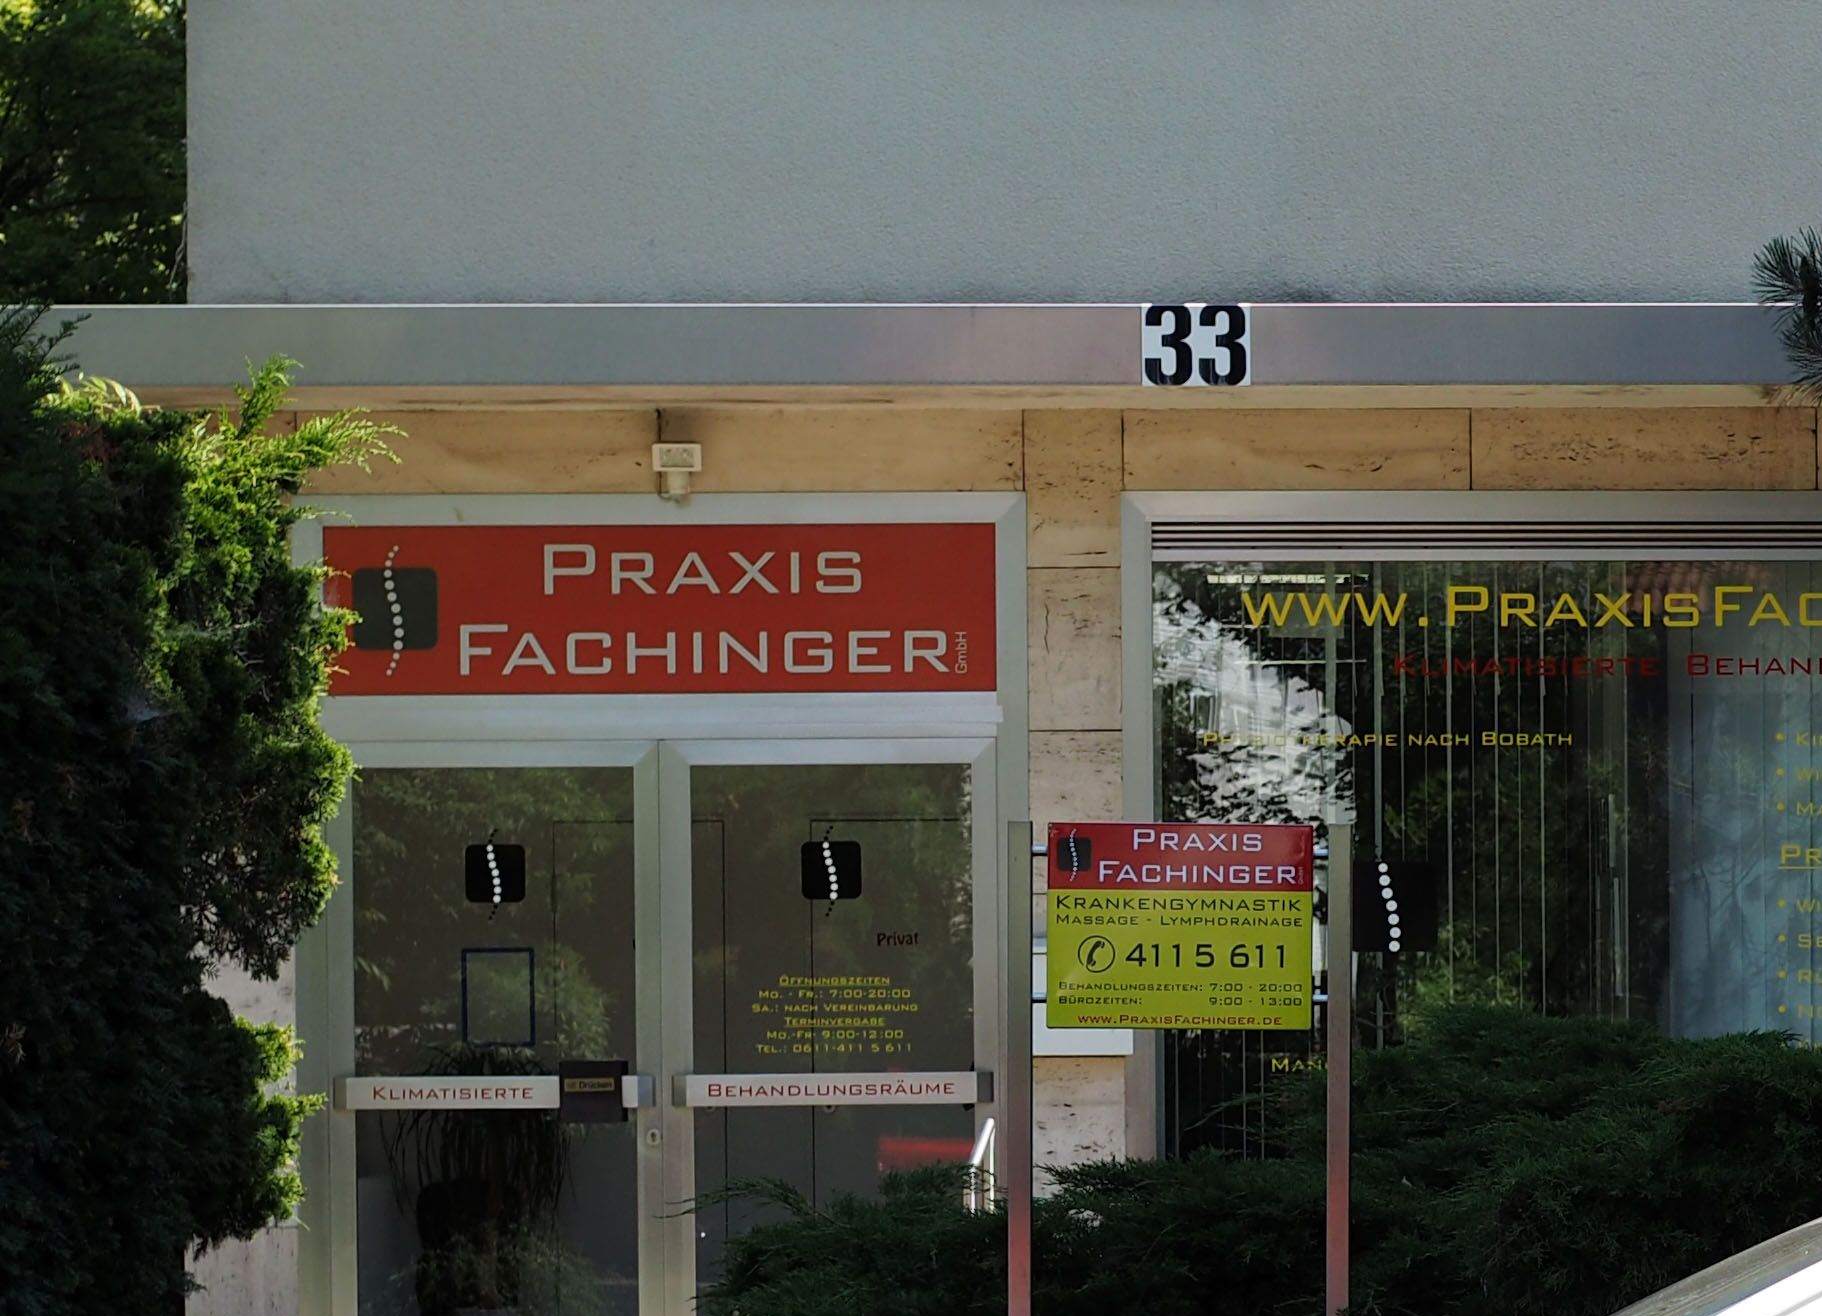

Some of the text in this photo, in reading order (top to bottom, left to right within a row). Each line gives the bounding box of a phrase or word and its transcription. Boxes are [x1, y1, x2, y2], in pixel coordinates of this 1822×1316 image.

[1145, 305, 1246, 385] 33
[543, 544, 863, 595] PRAXIS
[459, 623, 951, 676] FACHINGER
[955, 631, 969, 675] GmbH
[1393, 652, 1660, 677] KLIMATISIERTE
[1408, 732, 1470, 747] NACH
[1482, 730, 1573, 747] BOBATH
[1133, 828, 1263, 852] PRAXIS
[1099, 860, 1296, 885] FACHINGER
[1056, 895, 1302, 912] KRANKENGYMNASTIK
[1056, 914, 1139, 926] MASSAGE
[1160, 915, 1303, 928] LYMPHDRAINAGE
[877, 932, 920, 947] Privat
[1209, 982, 1243, 993] 7:00
[1259, 982, 1303, 993] 20:00
[1058, 994, 1142, 1006] BÜROZEITEN:
[1209, 996, 1243, 1007] 9:00
[1260, 996, 1303, 1007] 13:00
[372, 1085, 534, 1101] KLIMATISIERTE
[708, 1079, 956, 1098] BEHANDLUNGSRÄUME
